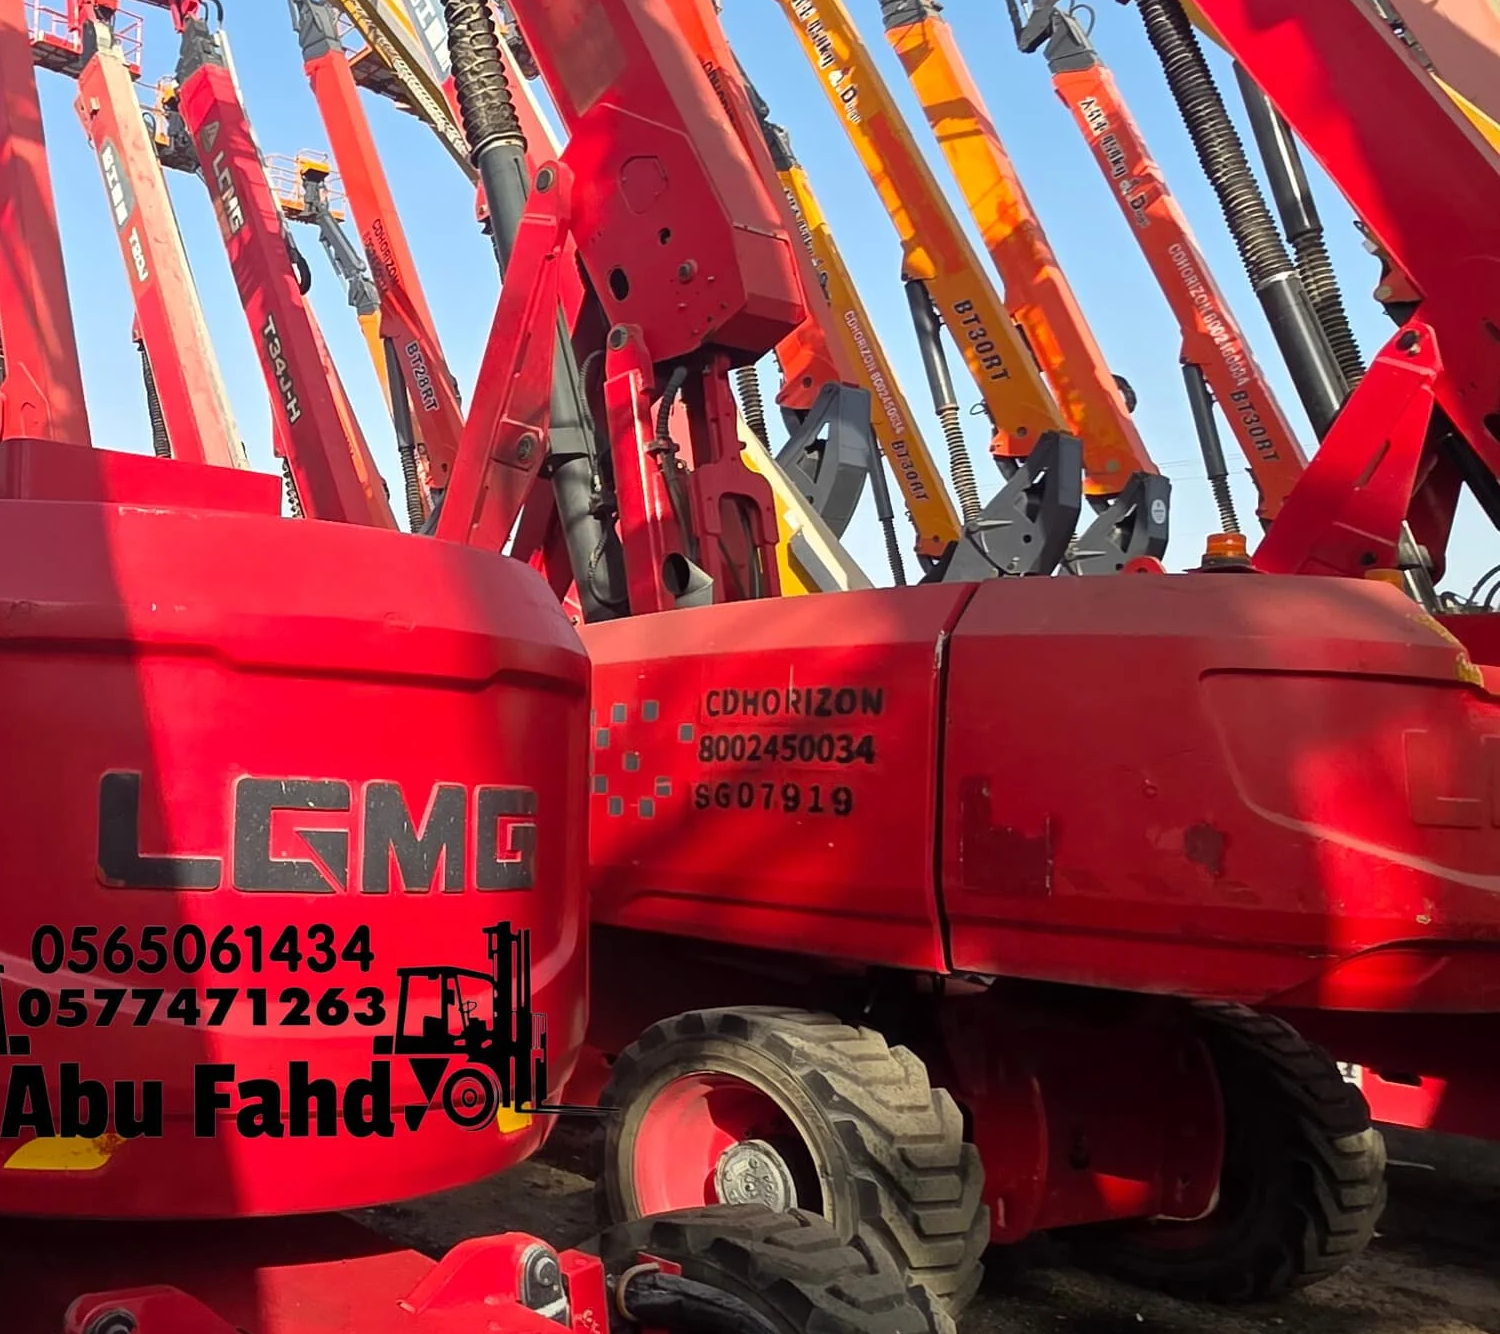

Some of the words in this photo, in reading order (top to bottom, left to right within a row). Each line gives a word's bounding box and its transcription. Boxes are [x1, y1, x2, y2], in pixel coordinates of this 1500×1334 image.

[262, 314, 301, 424] T34J-H
[954, 298, 1011, 381] BT30RT
[406, 341, 440, 413] BT28RT
[1231, 389, 1280, 462] BT30RT
[705, 687, 884, 717] CDHORIZON
[698, 733, 876, 764] 8002450034
[98, 770, 538, 894] LGMG
[695, 781, 854, 816] SG07919
